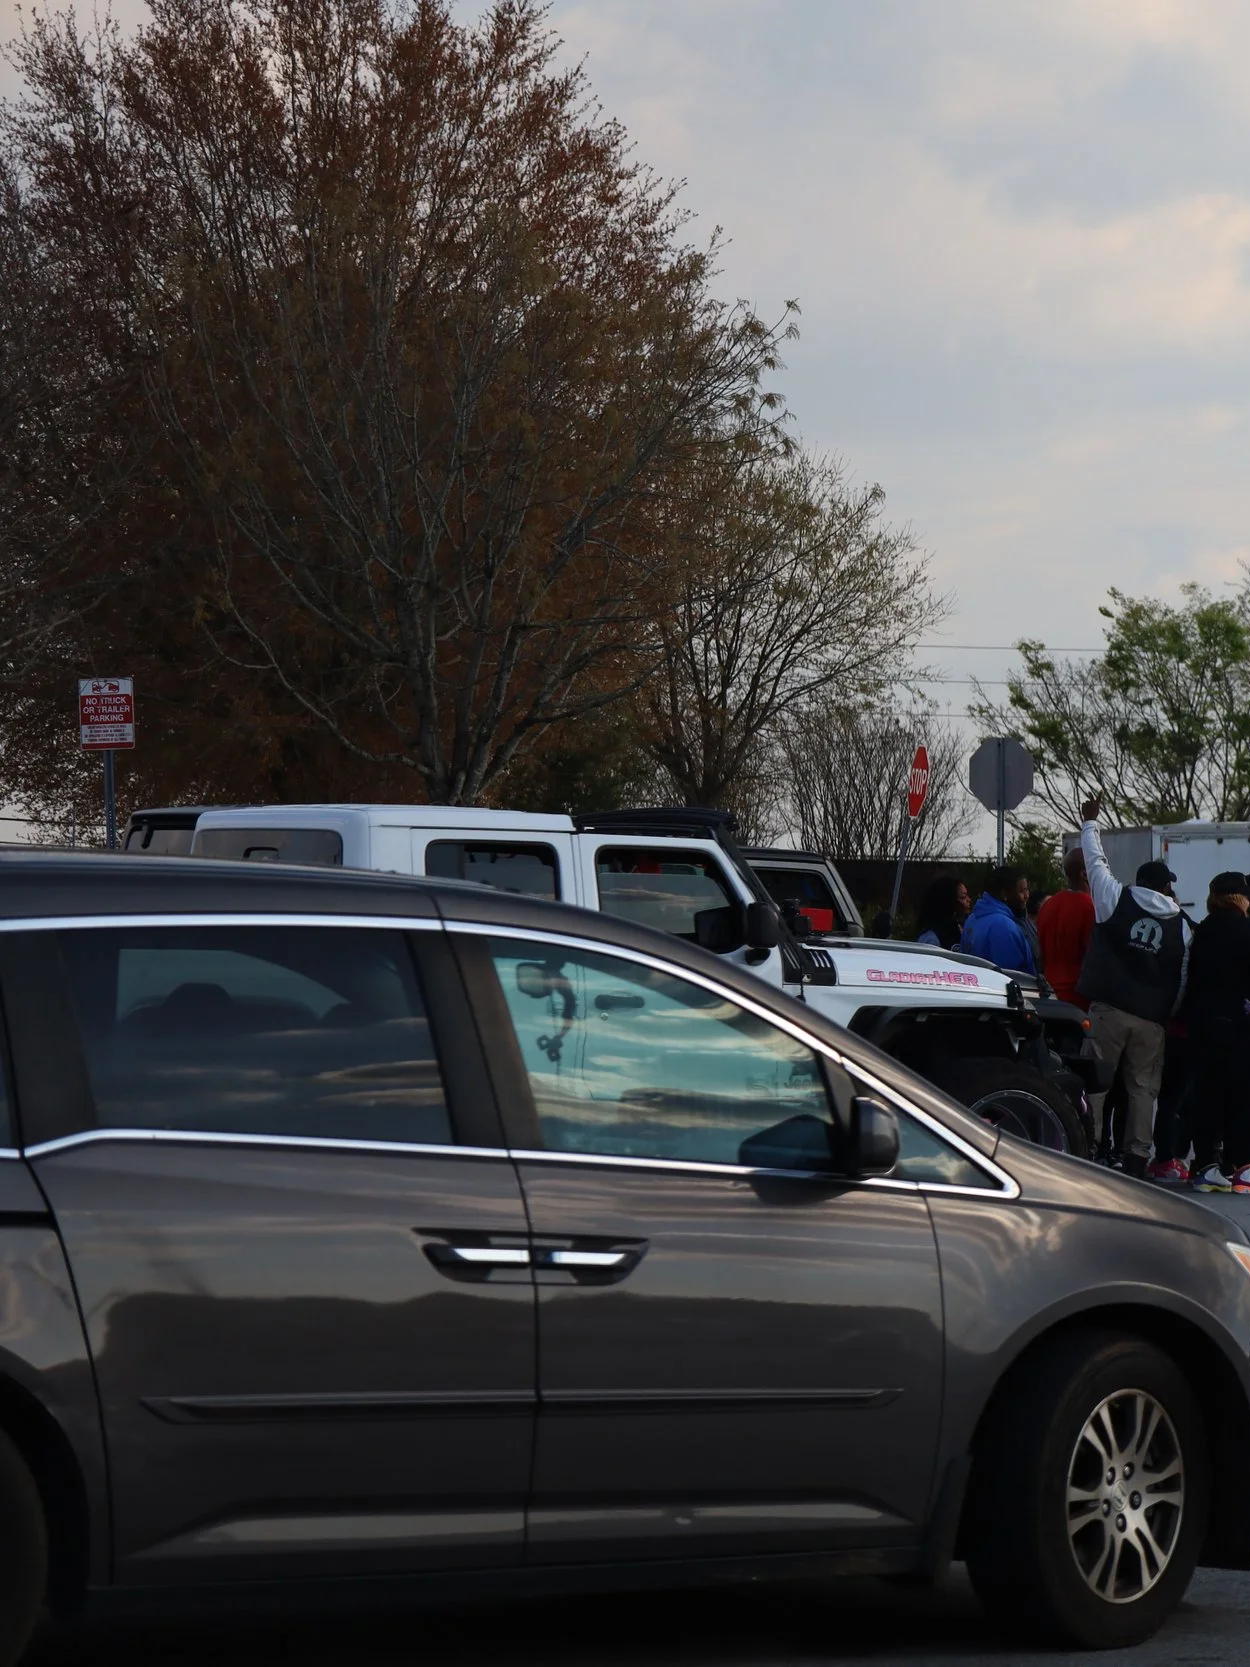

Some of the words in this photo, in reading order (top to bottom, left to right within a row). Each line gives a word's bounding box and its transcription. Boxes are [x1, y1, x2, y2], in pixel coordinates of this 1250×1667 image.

[85, 697, 97, 706] NO
[101, 697, 126, 705] TRUCK
[83, 706, 95, 714] OR
[98, 705, 130, 713] TRAILER
[90, 714, 124, 722] PARKING
[909, 768, 927, 795] STOP
